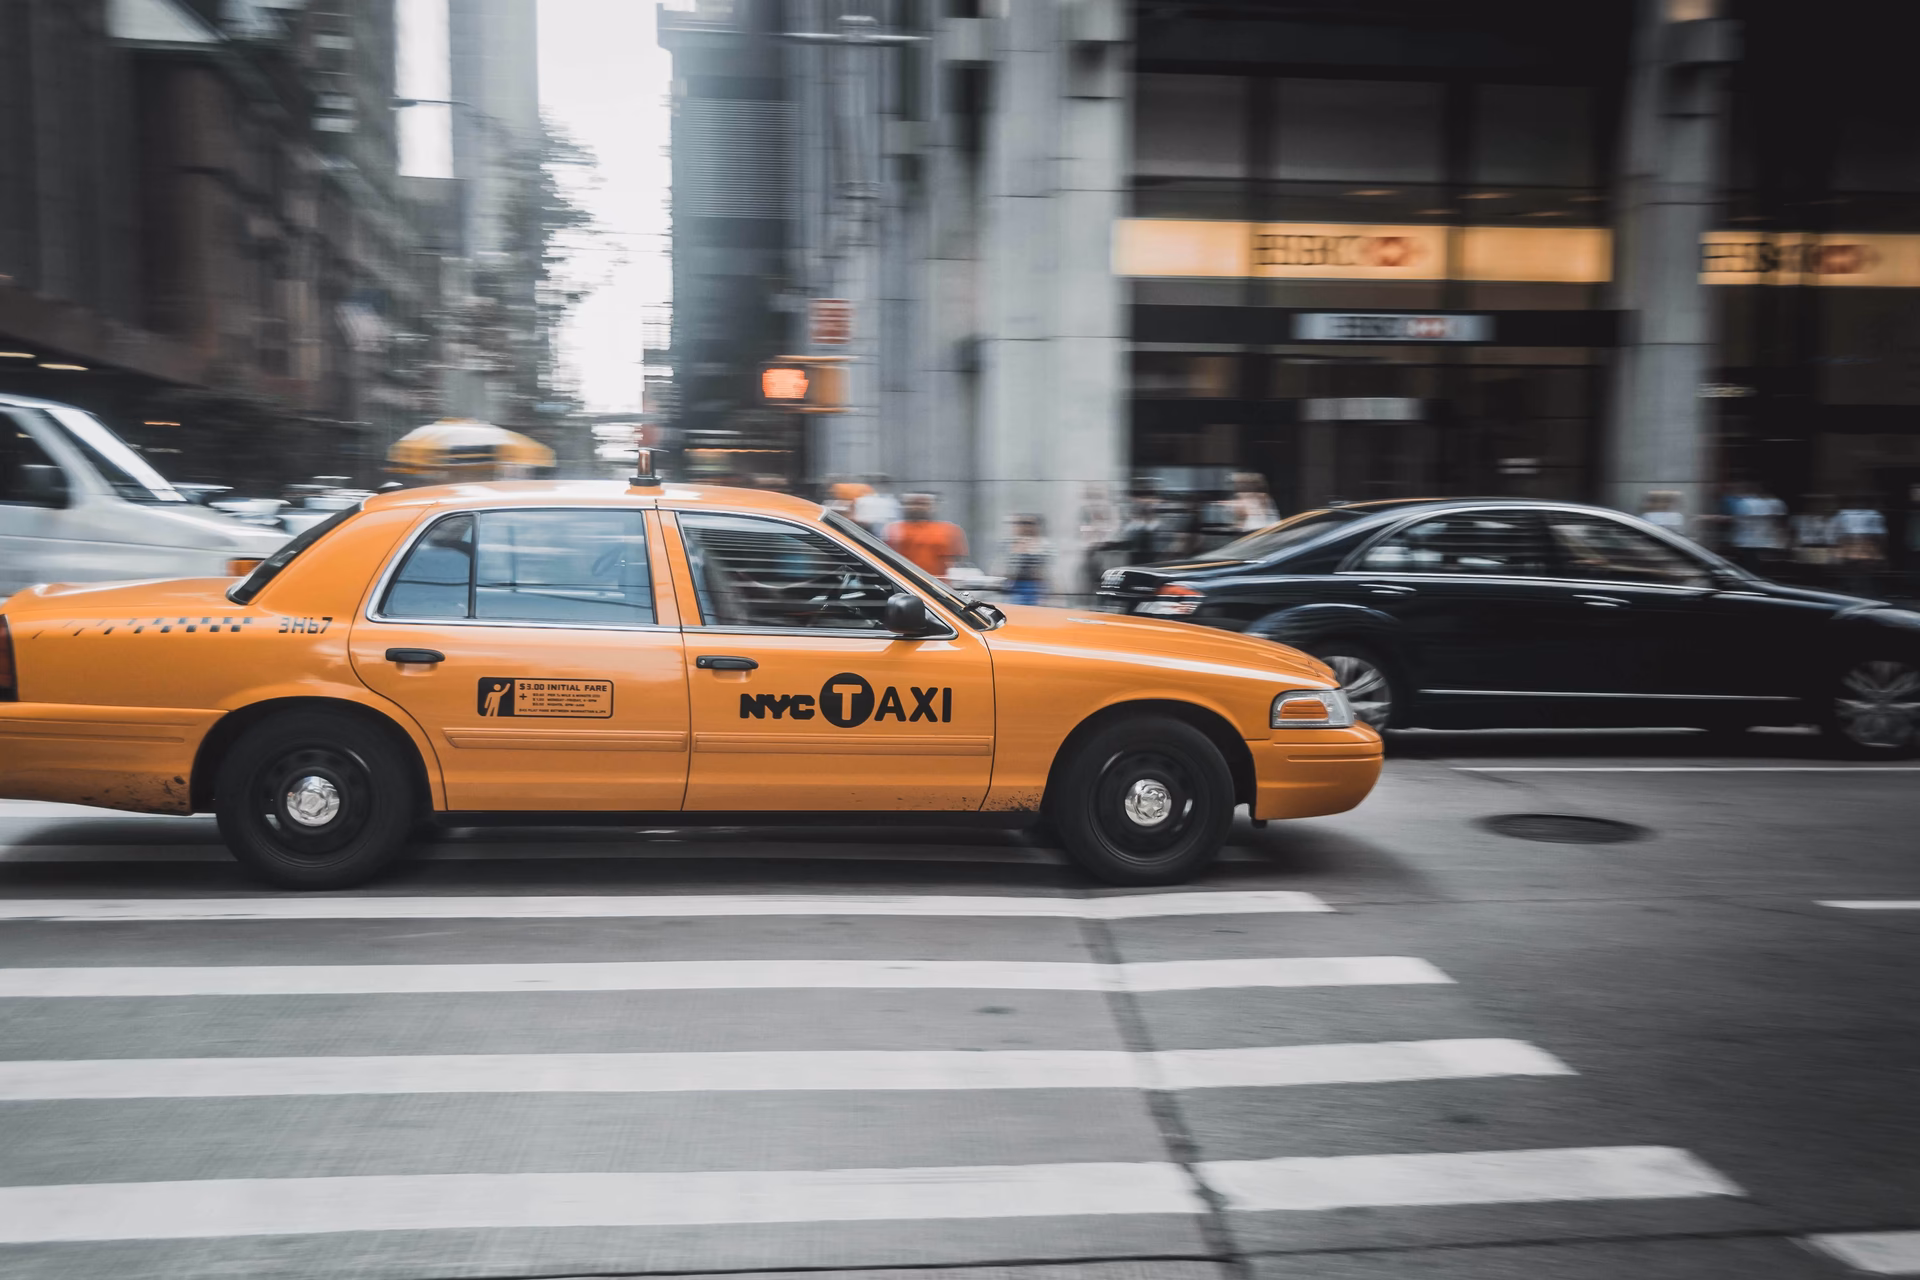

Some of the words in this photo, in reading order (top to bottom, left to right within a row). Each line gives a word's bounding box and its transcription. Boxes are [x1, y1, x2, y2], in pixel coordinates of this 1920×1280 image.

[278, 616, 333, 635] 3H67
[519, 683, 545, 691] $3.00
[547, 683, 581, 692] INITIAL
[584, 684, 608, 692] FARE
[740, 693, 815, 720] NYC
[819, 672, 953, 728] TAXI
